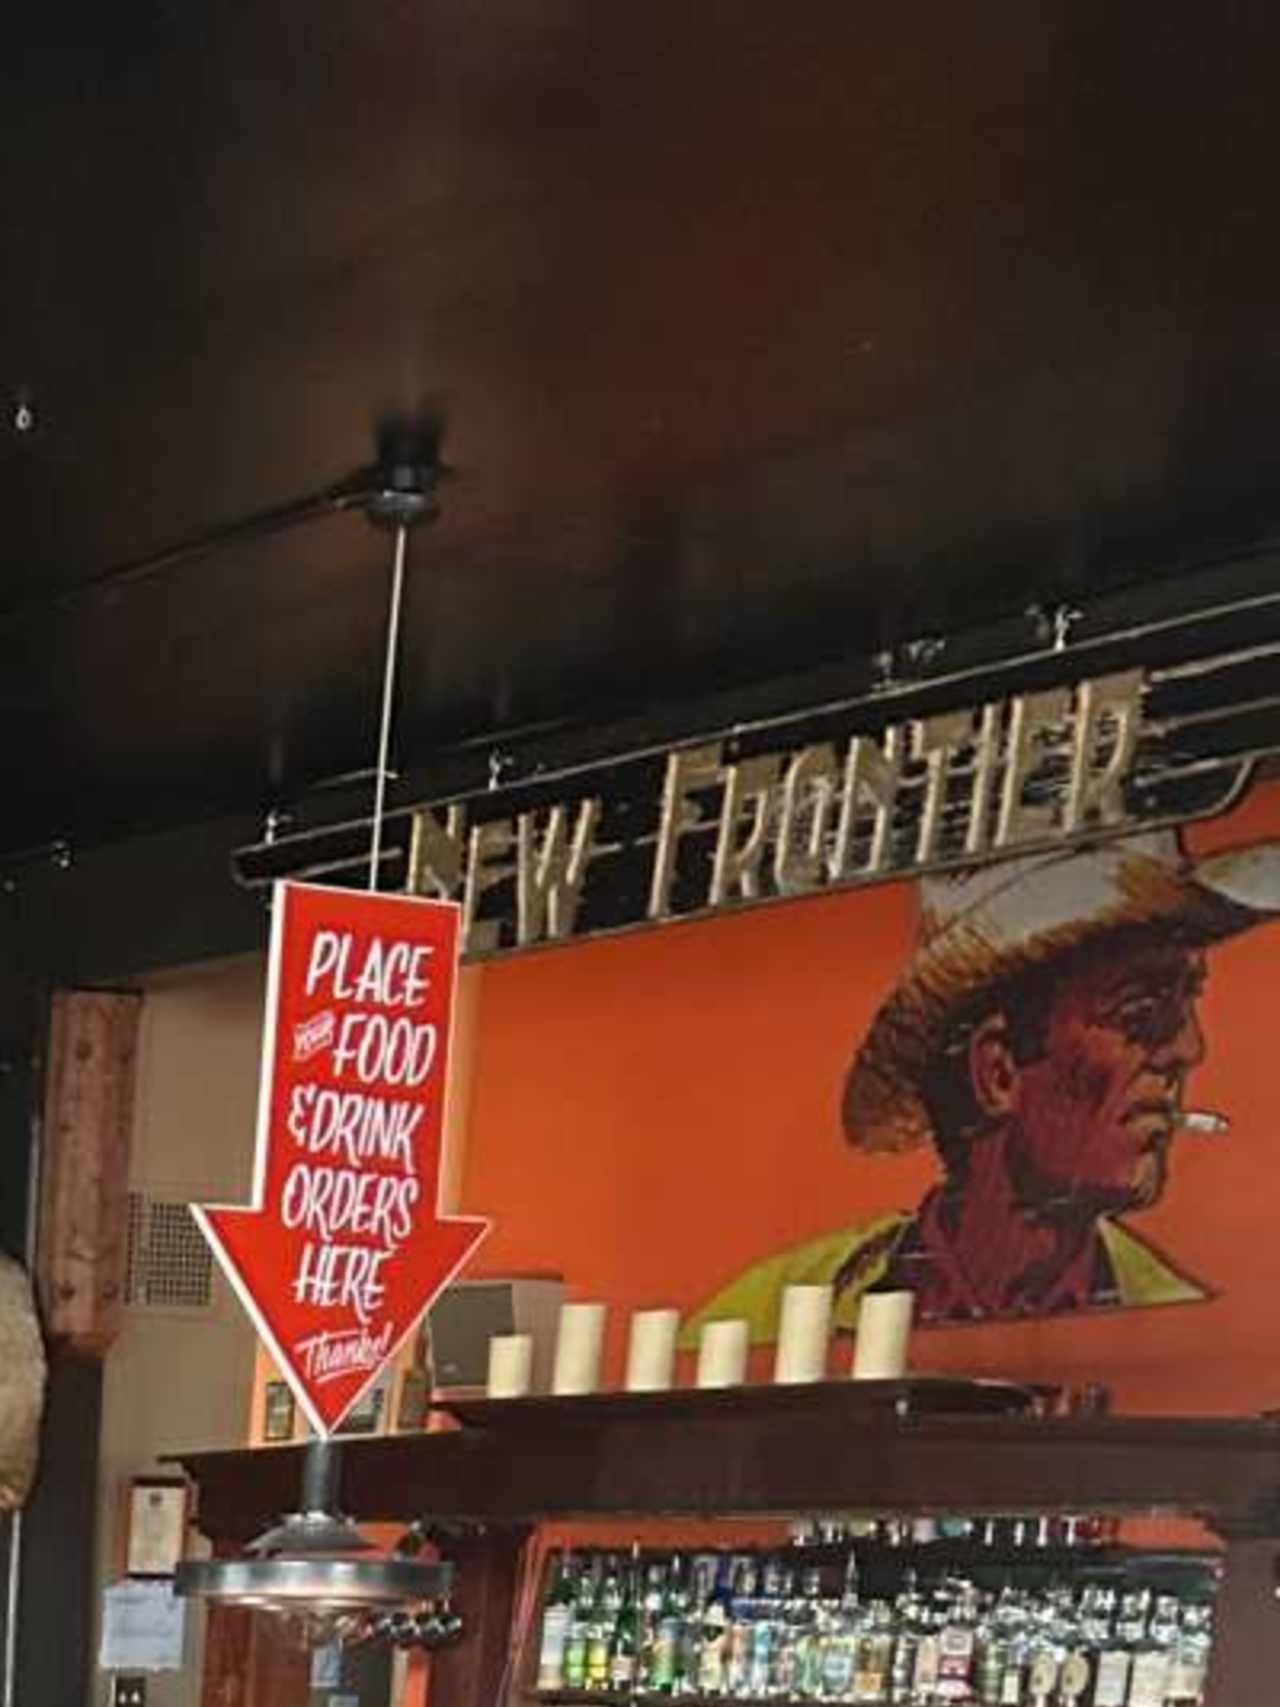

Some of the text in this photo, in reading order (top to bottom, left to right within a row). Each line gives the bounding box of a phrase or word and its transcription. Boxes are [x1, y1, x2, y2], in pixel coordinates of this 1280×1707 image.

[408, 664, 1151, 952] NEW FRONTIER
[306, 930, 435, 1007] PLACE
[333, 1012, 437, 1086] FOOD
[281, 1164, 419, 1249] ORDERS
[292, 1243, 396, 1324] HERE
[295, 1321, 394, 1376] Thanks!
